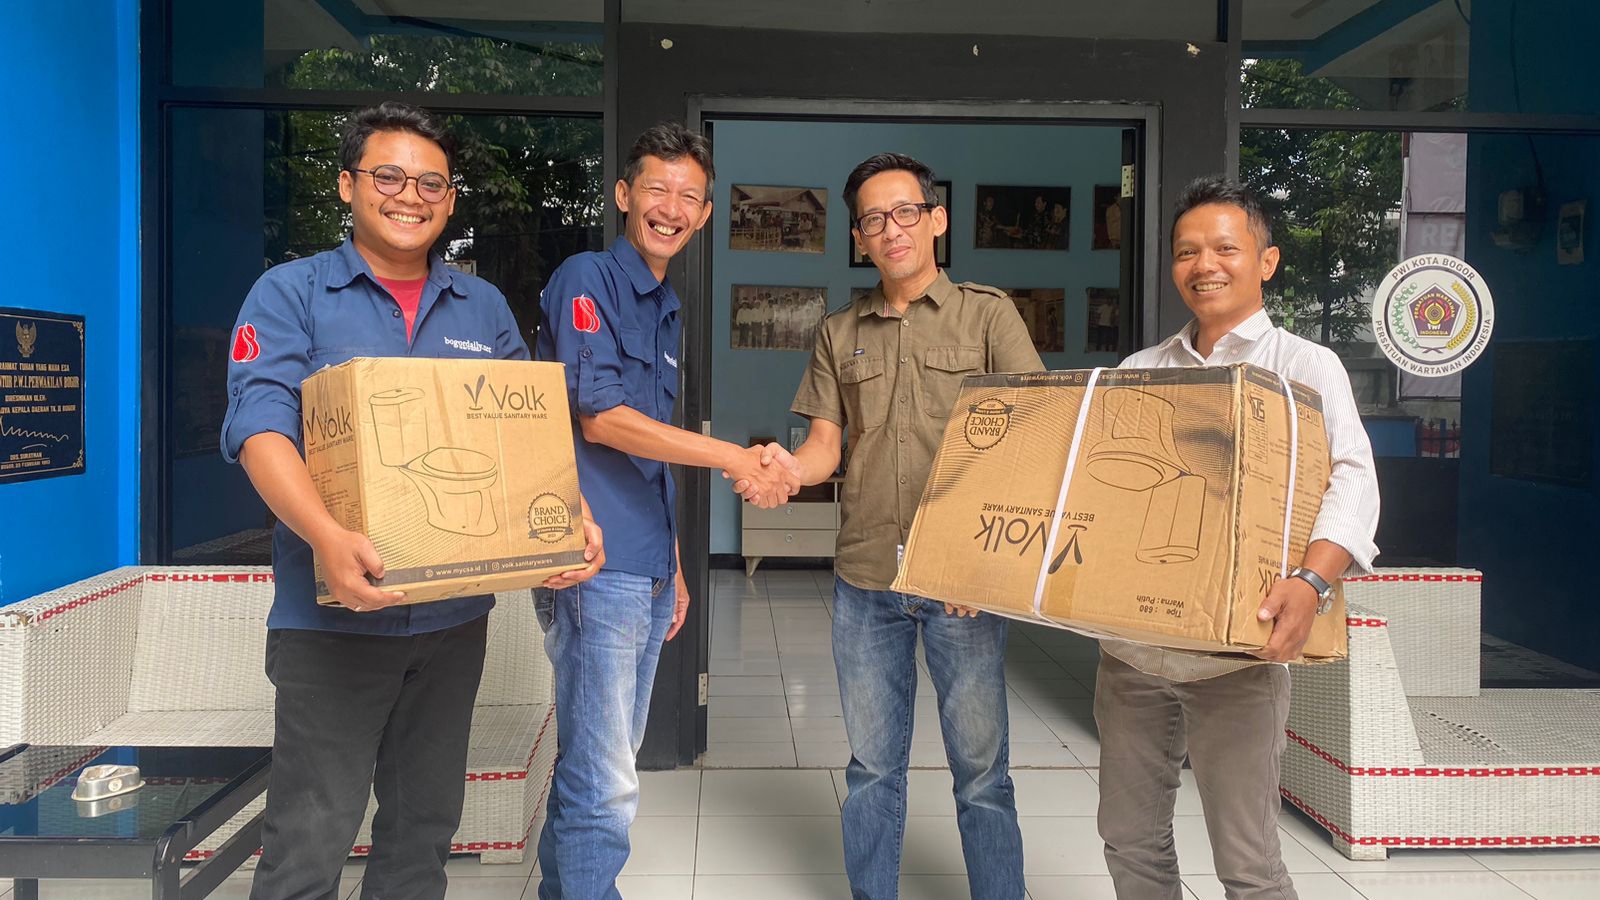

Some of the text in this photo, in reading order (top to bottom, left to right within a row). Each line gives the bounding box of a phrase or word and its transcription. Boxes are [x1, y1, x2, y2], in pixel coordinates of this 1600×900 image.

[1392, 257, 1475, 280] PWI KOTA BOGOR
[1376, 318, 1491, 375] PERSATUAN WARTAWAN INDONESIA
[488, 384, 546, 411] Volk
[12, 406, 30, 414] KEPALA
[316, 406, 352, 440] Volk
[970, 417, 1004, 426] CHOICE
[969, 426, 1001, 436] BRAND
[534, 505, 564, 516] BRAND
[982, 503, 1095, 522] BEST VAUE SANITARY WARE
[533, 515, 567, 525] CHOICE
[974, 514, 1047, 556] Volk
[436, 558, 553, 576] www.mycsa.id volk.sanitarywares
[1136, 595, 1156, 605] Putih
[1139, 605, 1154, 614] 680
[1166, 608, 1182, 618] Tipe
